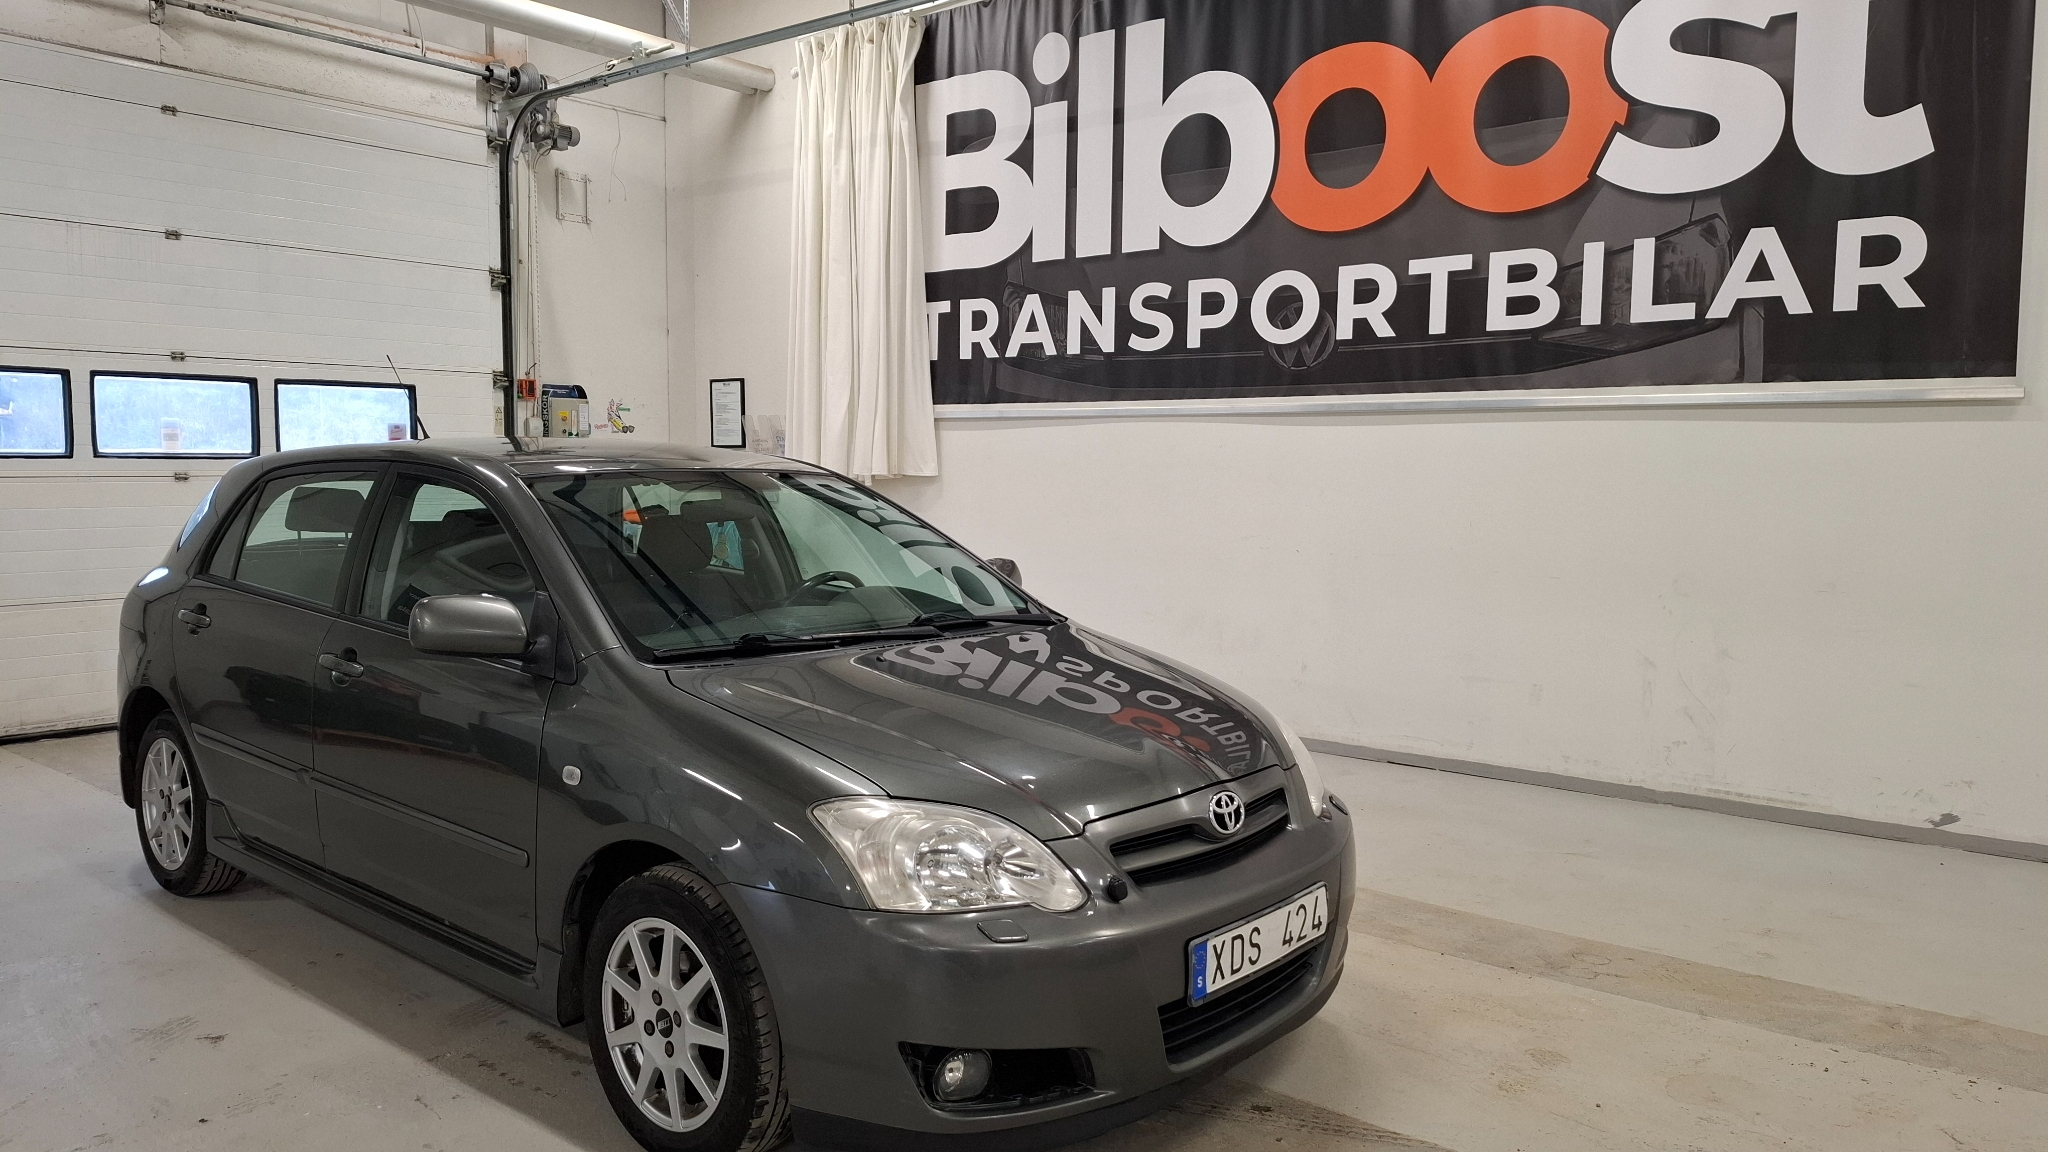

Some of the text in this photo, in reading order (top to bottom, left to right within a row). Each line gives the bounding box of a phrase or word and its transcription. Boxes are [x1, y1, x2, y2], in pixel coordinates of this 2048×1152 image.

[915, 0, 1935, 273] Bilboost
[926, 215, 1929, 361] TRANSPORTBILAR
[1197, 975, 1203, 988] S
[1211, 895, 1323, 985] XDS 424
